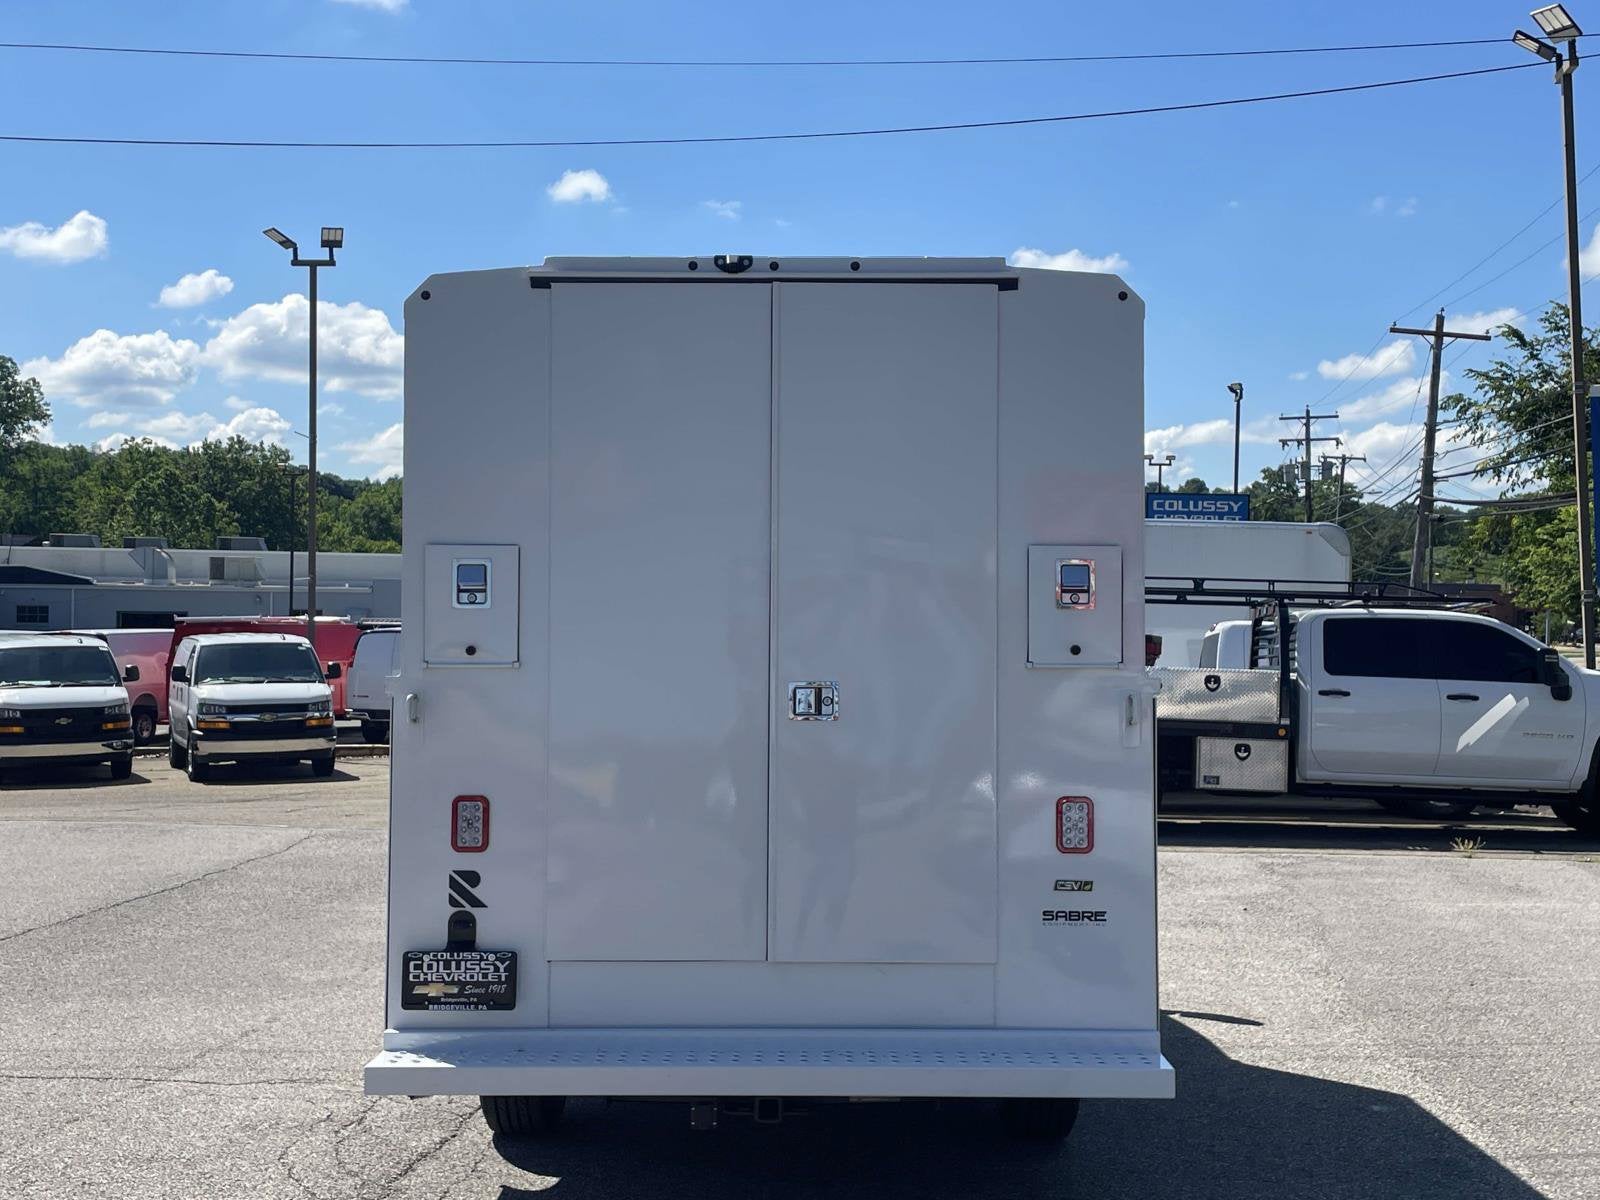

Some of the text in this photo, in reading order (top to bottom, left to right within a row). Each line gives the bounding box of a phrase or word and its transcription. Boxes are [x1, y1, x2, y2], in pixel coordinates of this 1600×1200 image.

[1152, 499, 1243, 512] COLUSSY
[1042, 910, 1107, 922] SABRE
[430, 952, 489, 960] COLUSSY
[409, 961, 510, 973] COLUSSY
[409, 973, 509, 982] CHEVROLET
[464, 984, 508, 995] Since 1918
